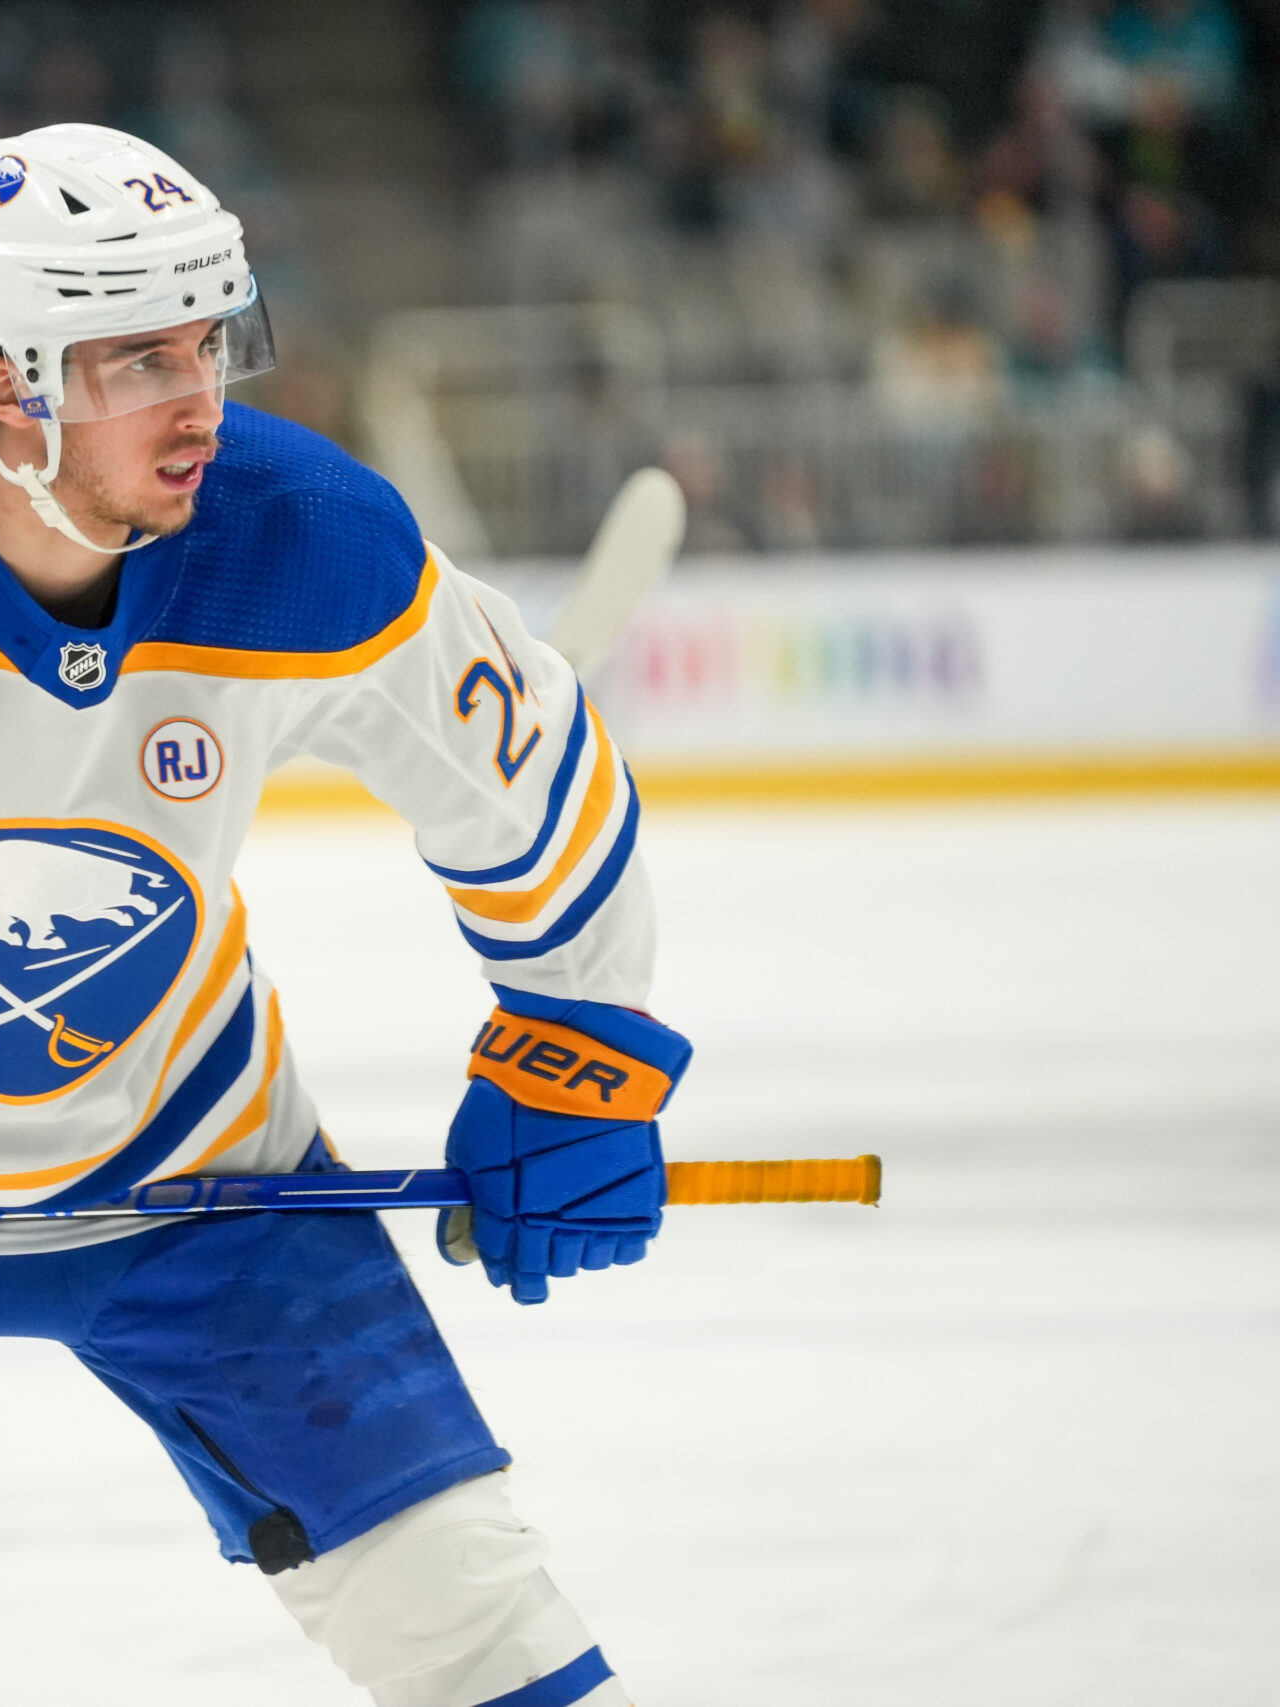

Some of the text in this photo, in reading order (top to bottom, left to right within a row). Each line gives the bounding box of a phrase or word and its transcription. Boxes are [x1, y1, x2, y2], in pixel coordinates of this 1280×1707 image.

[123, 172, 194, 213] 24
[69, 656, 97, 680] NHL
[156, 738, 208, 784] RJ
[471, 1021, 629, 1102] UER
